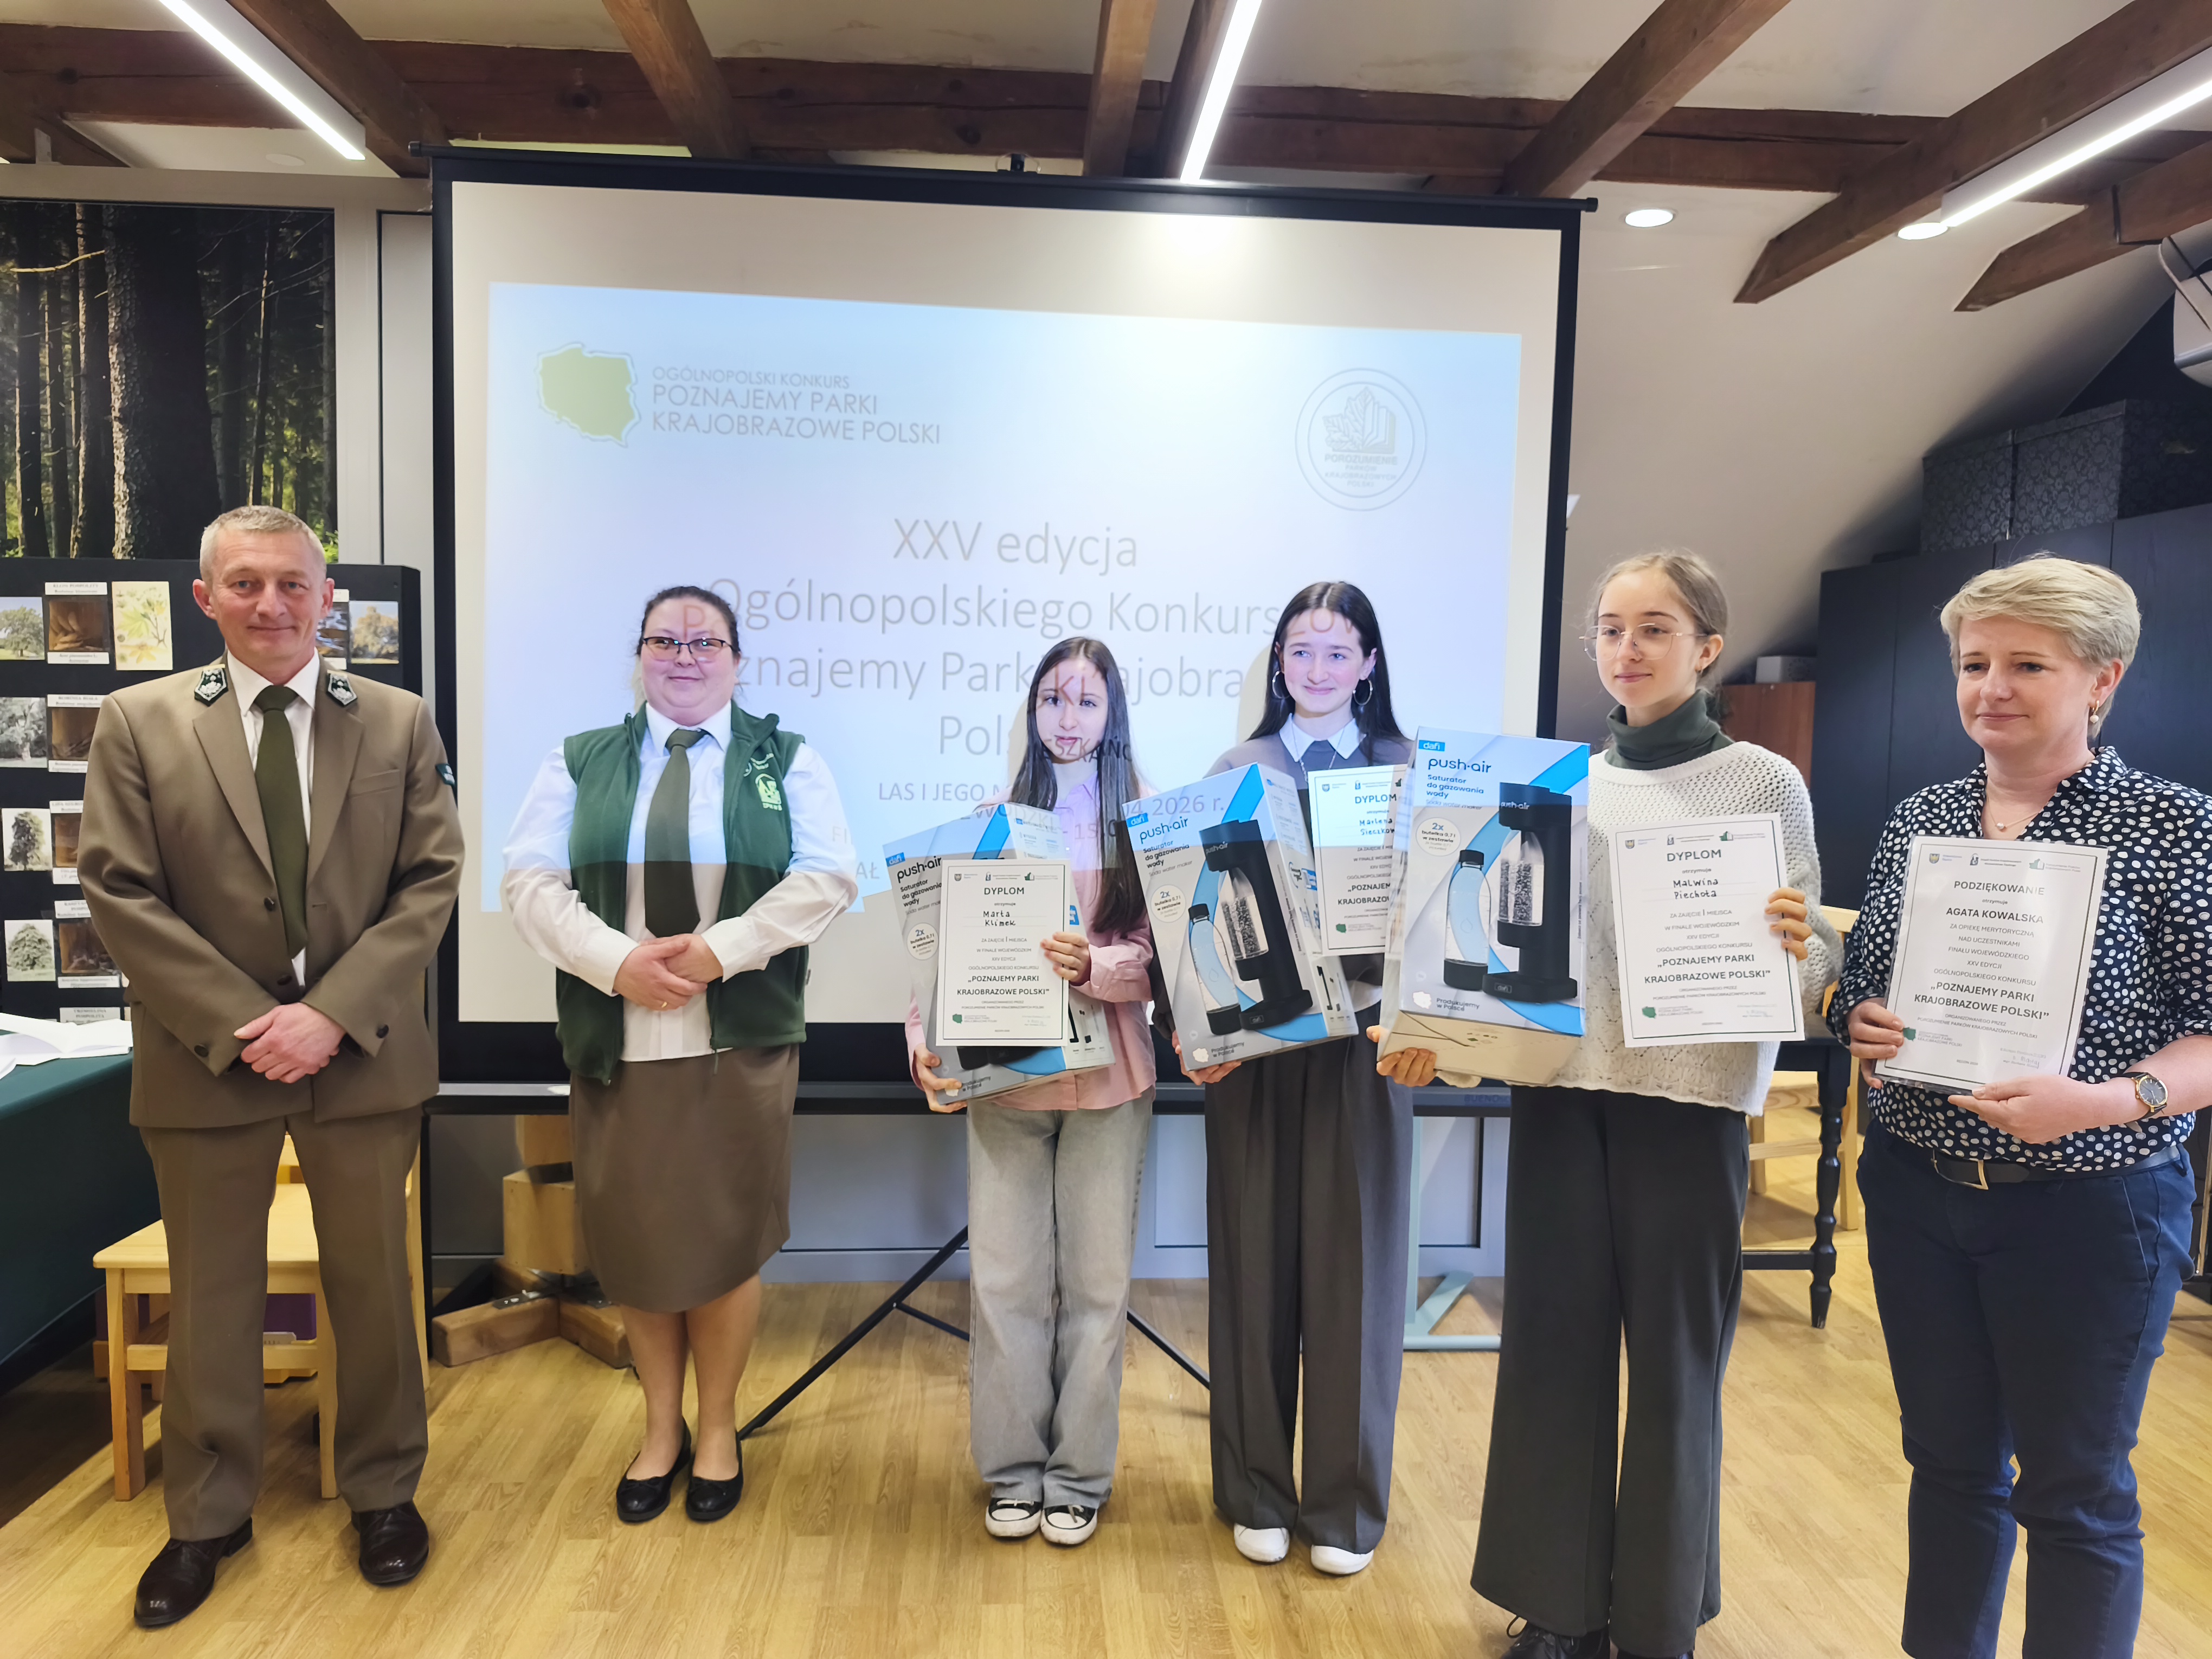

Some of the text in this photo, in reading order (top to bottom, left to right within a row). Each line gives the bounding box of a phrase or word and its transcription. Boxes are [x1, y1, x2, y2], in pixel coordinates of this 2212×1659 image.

[653, 365, 850, 389] OGÓLNOPOLSKI KONKURS
[653, 384, 877, 415] POZNAJEMY PARKI
[653, 412, 940, 445] KRAJOBRAZOWE POLSKI
[893, 518, 1137, 574] XXV edycja
[710, 578, 1278, 640] Ogólnopolskiego Konkurs
[942, 651, 1033, 693] Park
[1427, 774, 1467, 783] Saturator
[878, 783, 916, 800] LAS
[933, 783, 984, 801] JEGO
[1426, 790, 1449, 799] wody
[1439, 785, 1484, 794] gazowania
[1355, 794, 1397, 803] DYPLOM
[1143, 840, 1173, 853] Saturator
[1154, 844, 1189, 860] gazowania
[1667, 850, 1721, 861] DYPLOM
[1147, 859, 1164, 869] wody
[900, 879, 928, 892] Saturator
[1674, 878, 1719, 888] Malwina
[1954, 880, 2045, 895] PODZIĘKOWANIE
[984, 887, 1024, 895] DYPLOM
[903, 898, 919, 907] wody
[1946, 908, 2043, 924] AGATA KOWALSKA
[1973, 937, 2020, 947] UCZESTNIKAMI
[1725, 954, 1754, 963] PARKI
[1971, 949, 2029, 960] WOJEWÓDZKIEGO
[1644, 972, 1726, 984] KRAJOBRAZOWE
[1998, 976, 2036, 986] KONKURSU
[2001, 989, 2034, 1002] PARKI
[1914, 994, 1998, 1012] KRAJOBRAZOWE
